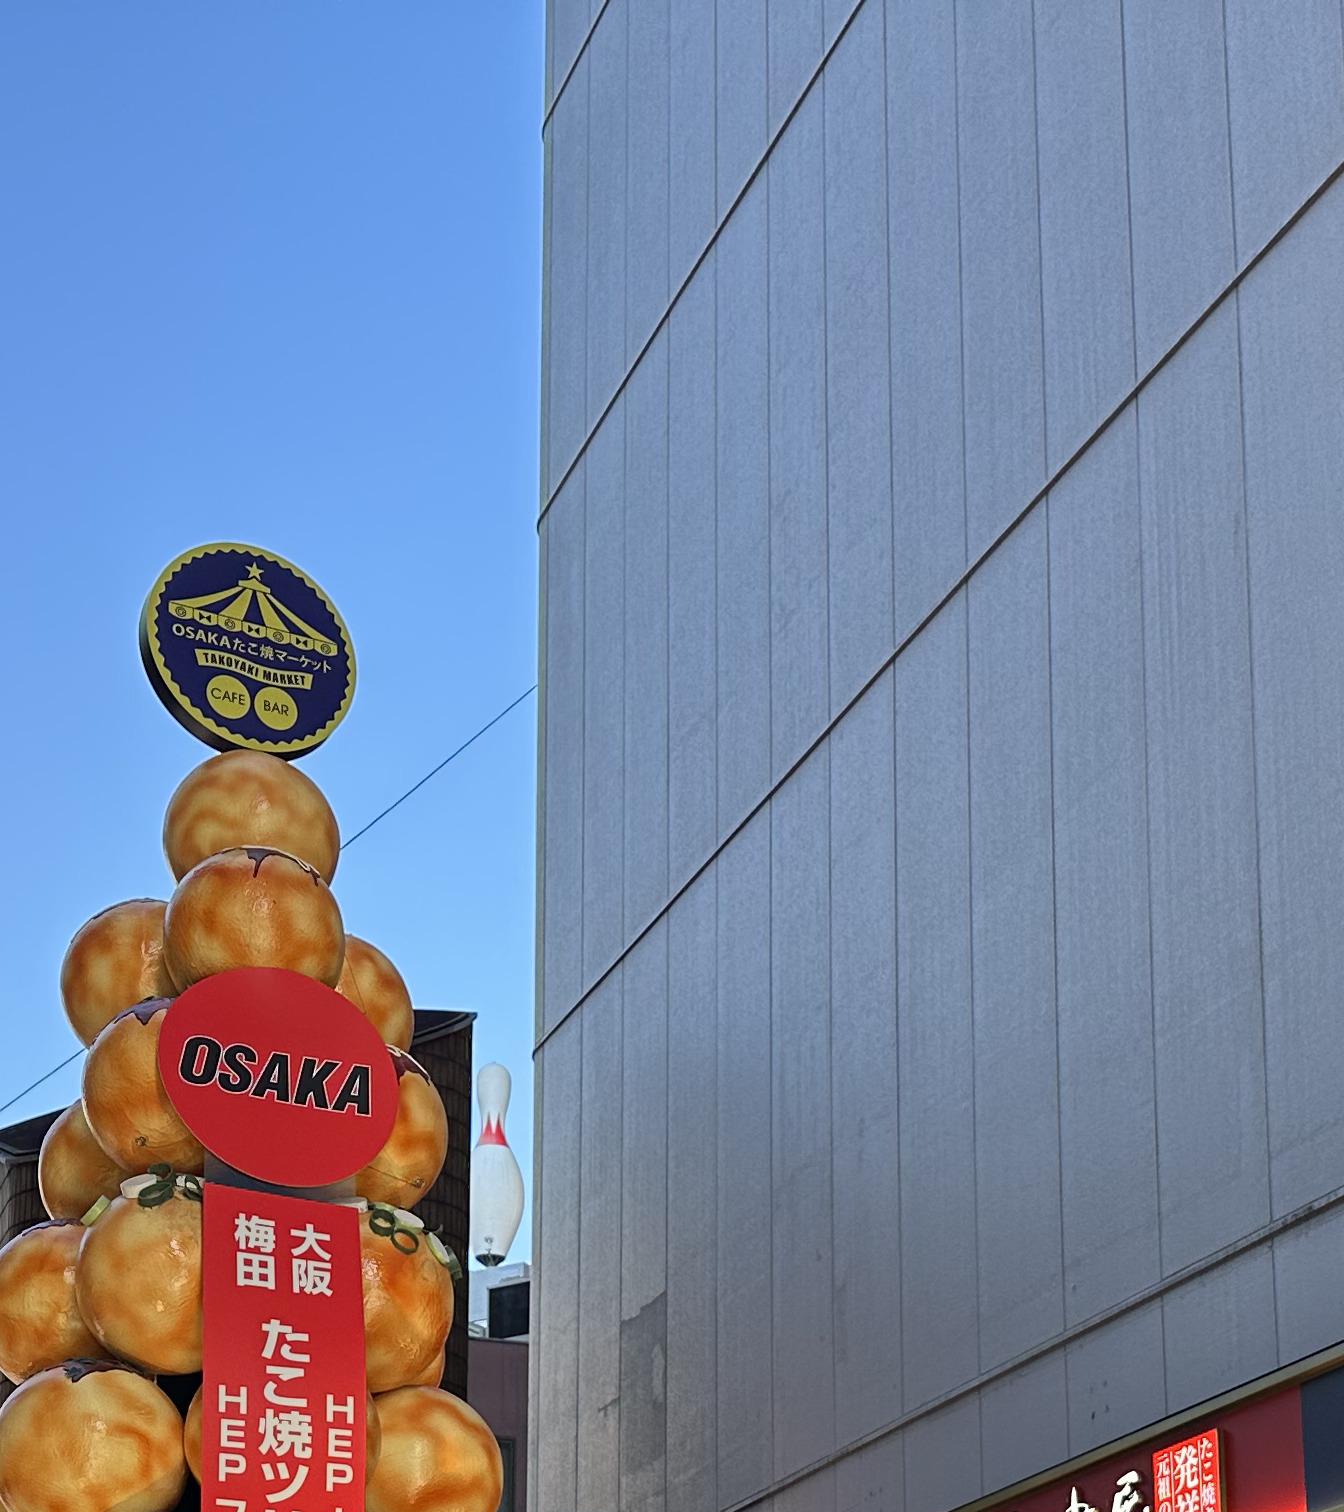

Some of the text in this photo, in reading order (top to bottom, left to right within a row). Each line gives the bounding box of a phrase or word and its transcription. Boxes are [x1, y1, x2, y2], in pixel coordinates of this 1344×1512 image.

[172, 623, 332, 674] OSAKAたこ焼マーケット
[202, 652, 306, 687] TAKOYAKI MARKET
[210, 687, 246, 706] CAFE
[263, 700, 289, 717] BAR
[178, 1034, 373, 1118] OSAKA
[233, 1212, 277, 1290] 梅田
[289, 1222, 335, 1297] 大阪
[217, 1383, 248, 1483] HEP
[325, 1393, 355, 1493] HEP
